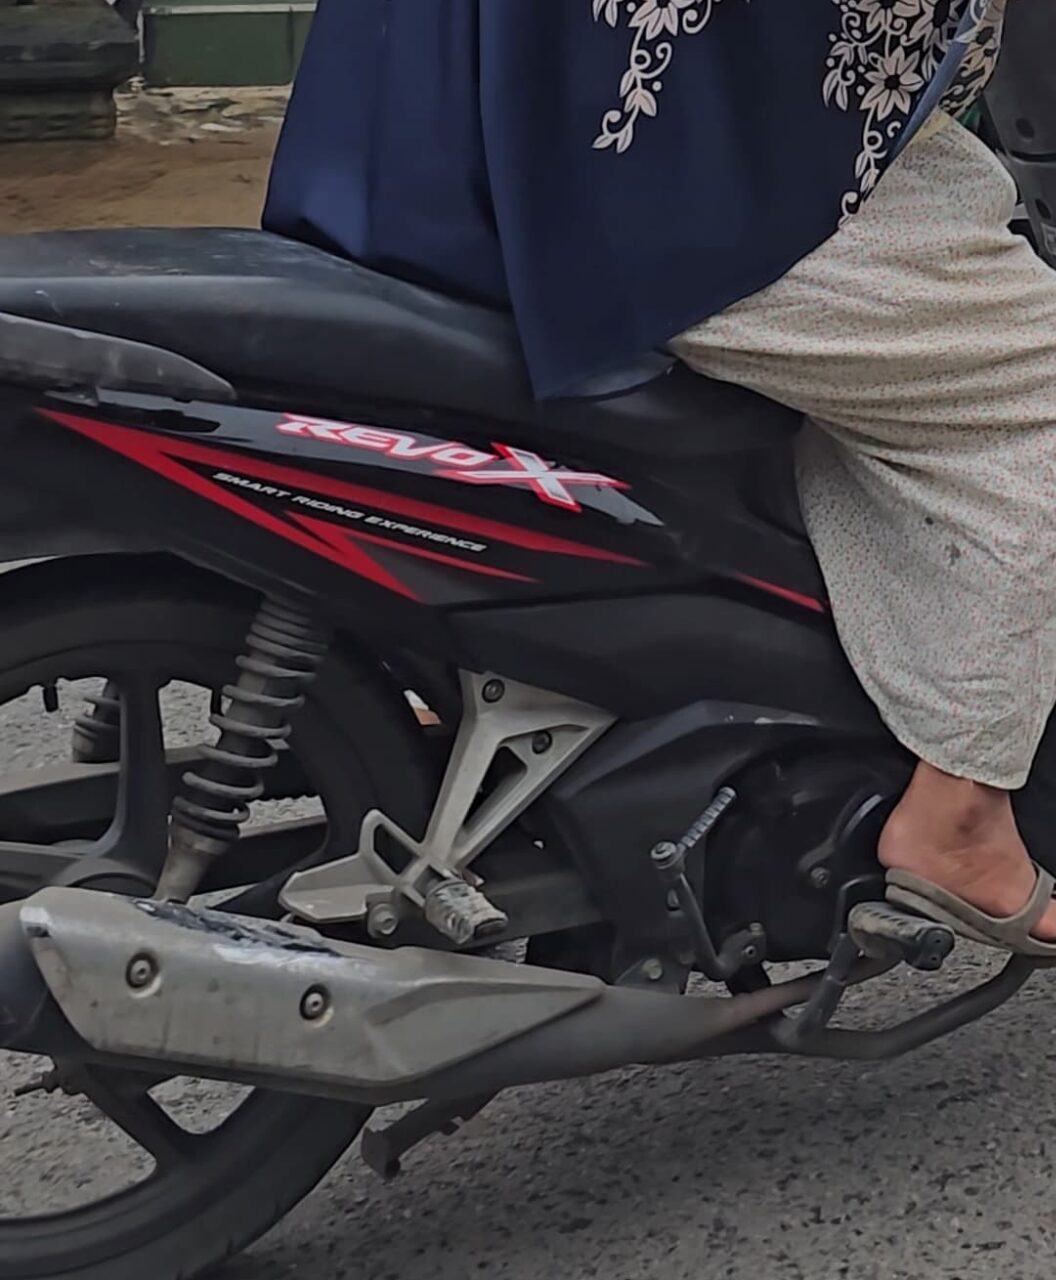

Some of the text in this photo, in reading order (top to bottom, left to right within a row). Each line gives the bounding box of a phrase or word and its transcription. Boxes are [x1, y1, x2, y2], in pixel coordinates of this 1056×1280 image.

[212, 471, 488, 553] SMART RIDING EXPERIENCE
